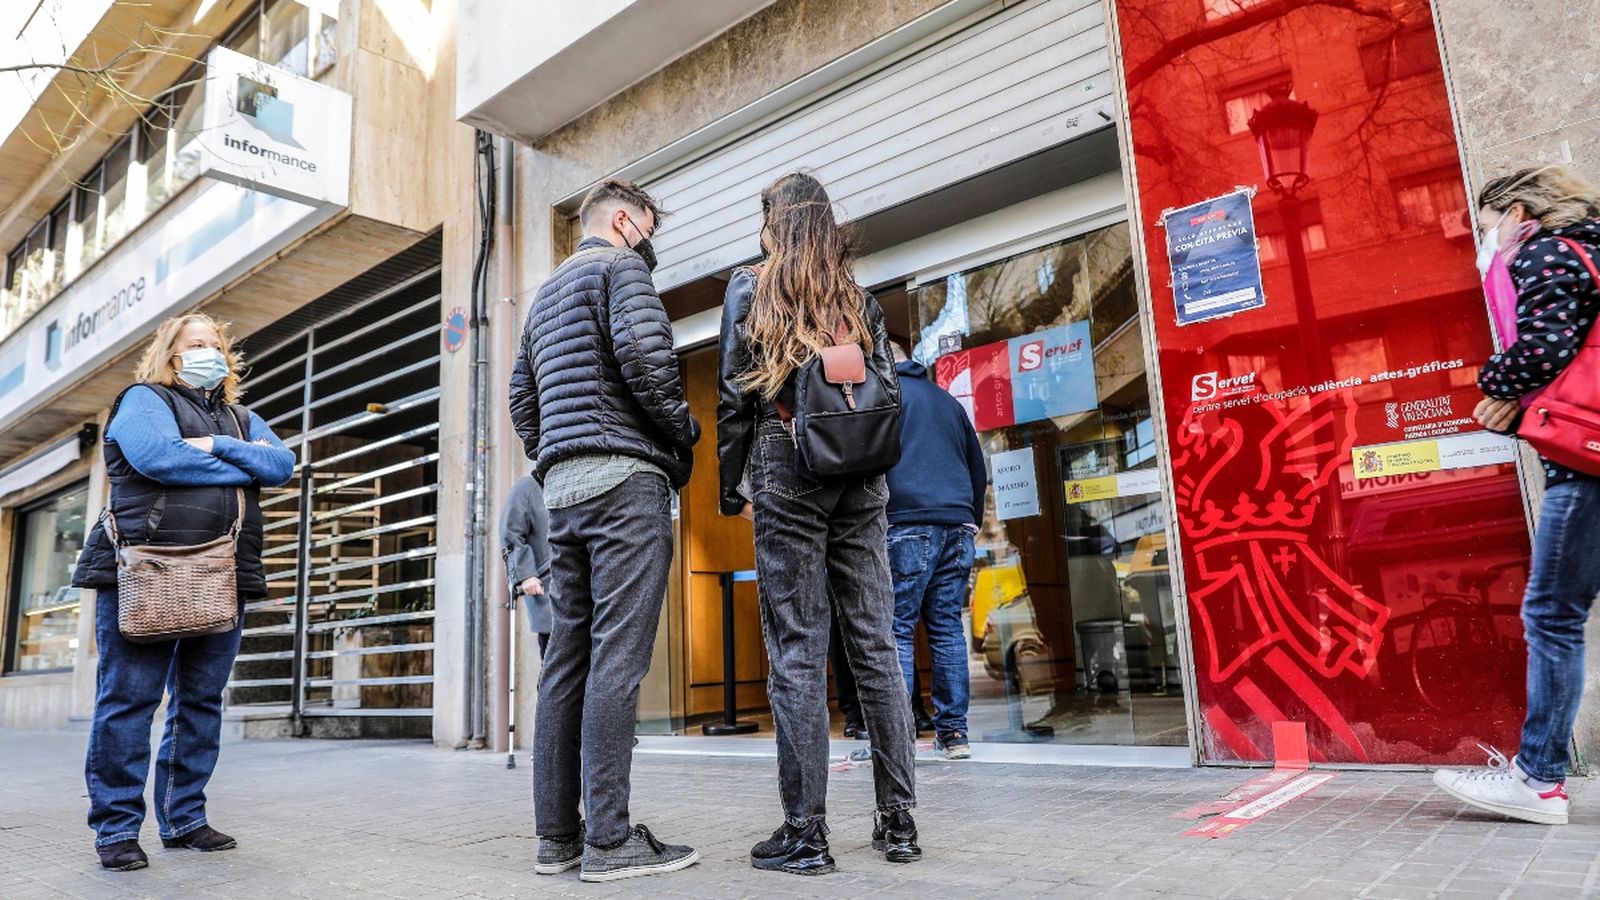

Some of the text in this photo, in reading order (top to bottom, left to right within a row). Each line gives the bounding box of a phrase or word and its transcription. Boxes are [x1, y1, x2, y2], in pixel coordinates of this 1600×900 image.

[224, 133, 317, 173] informance
[1175, 226, 1248, 252] CON CITA PREVIA
[64, 276, 145, 353] informance
[1019, 339, 1082, 372] Servef
[1192, 371, 1255, 401] Servef
[1192, 401, 1221, 414] centre
[1310, 375, 1362, 393] valència
[1400, 395, 1451, 413] GENERALITAT
[1402, 406, 1453, 421] VALENCIANA
